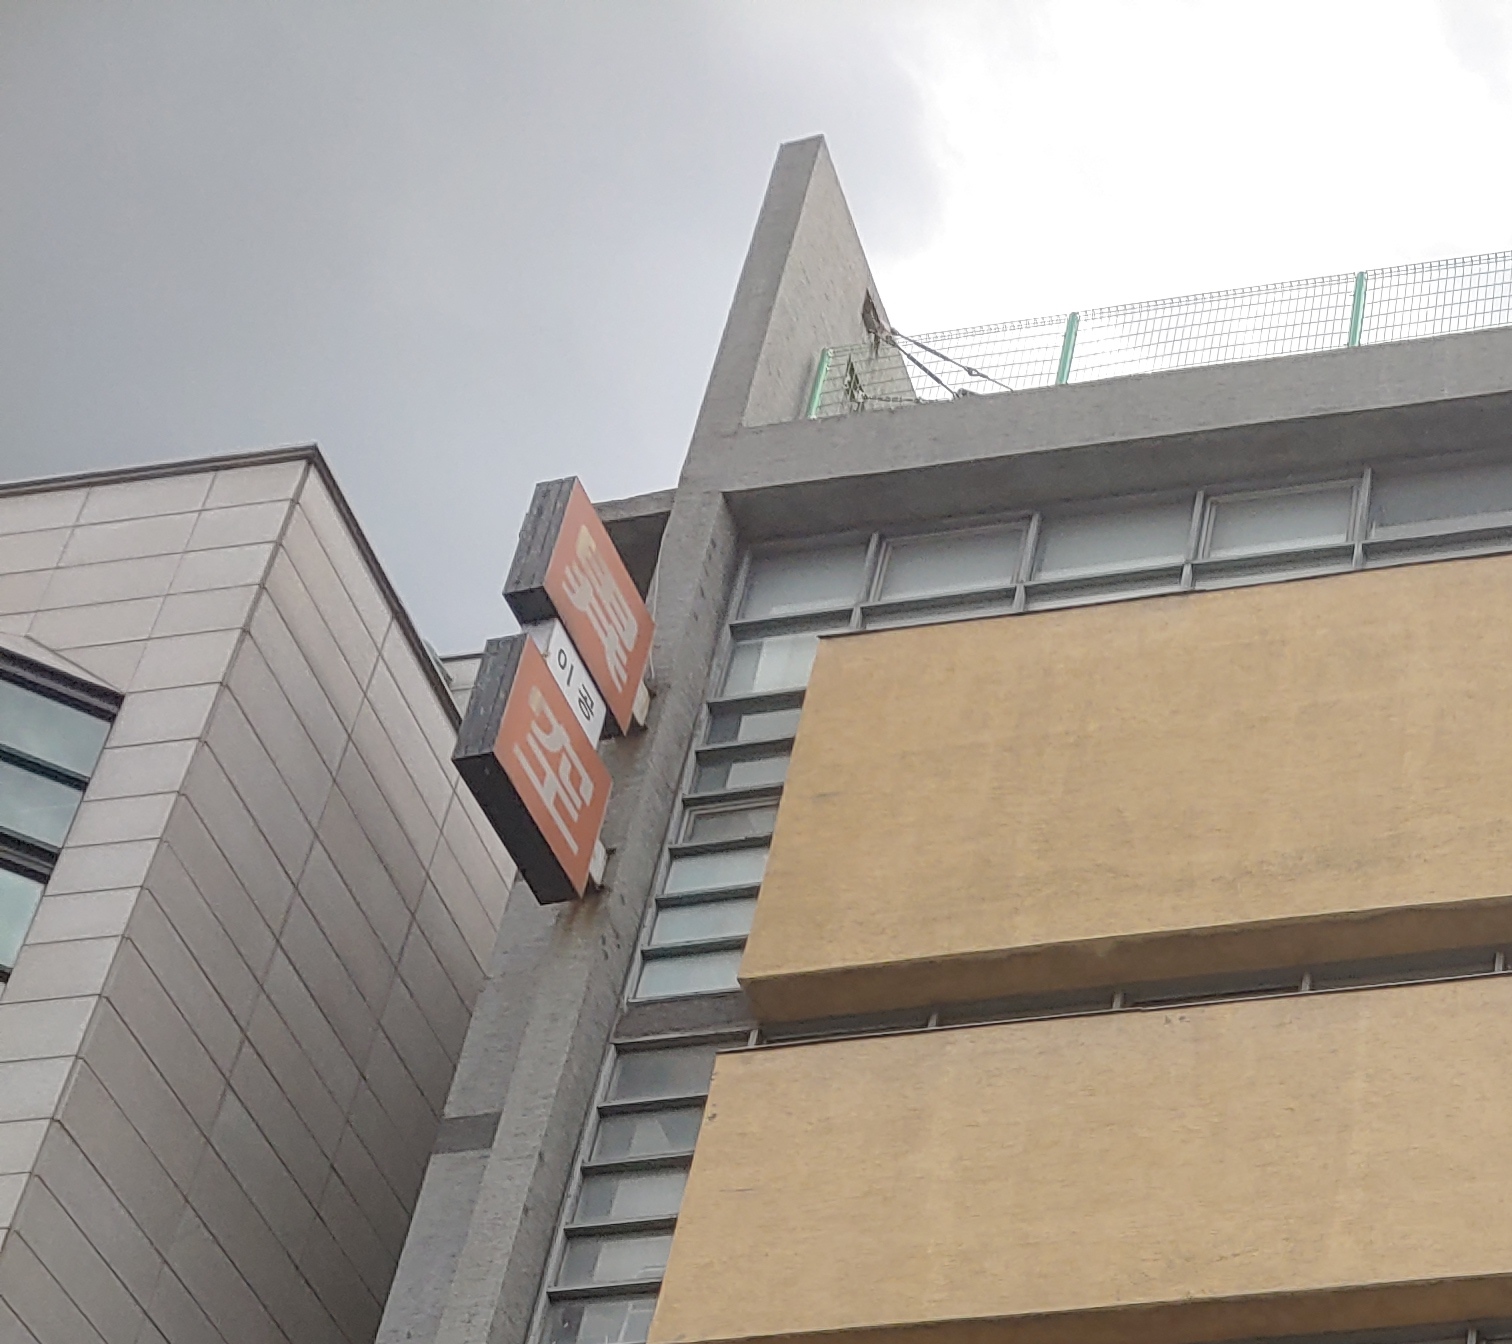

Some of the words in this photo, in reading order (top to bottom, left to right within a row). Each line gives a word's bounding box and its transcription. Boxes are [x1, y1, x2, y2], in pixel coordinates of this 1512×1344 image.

[556, 647, 595, 722] 이공
[561, 524, 639, 694] 異
[512, 685, 596, 857] 空
